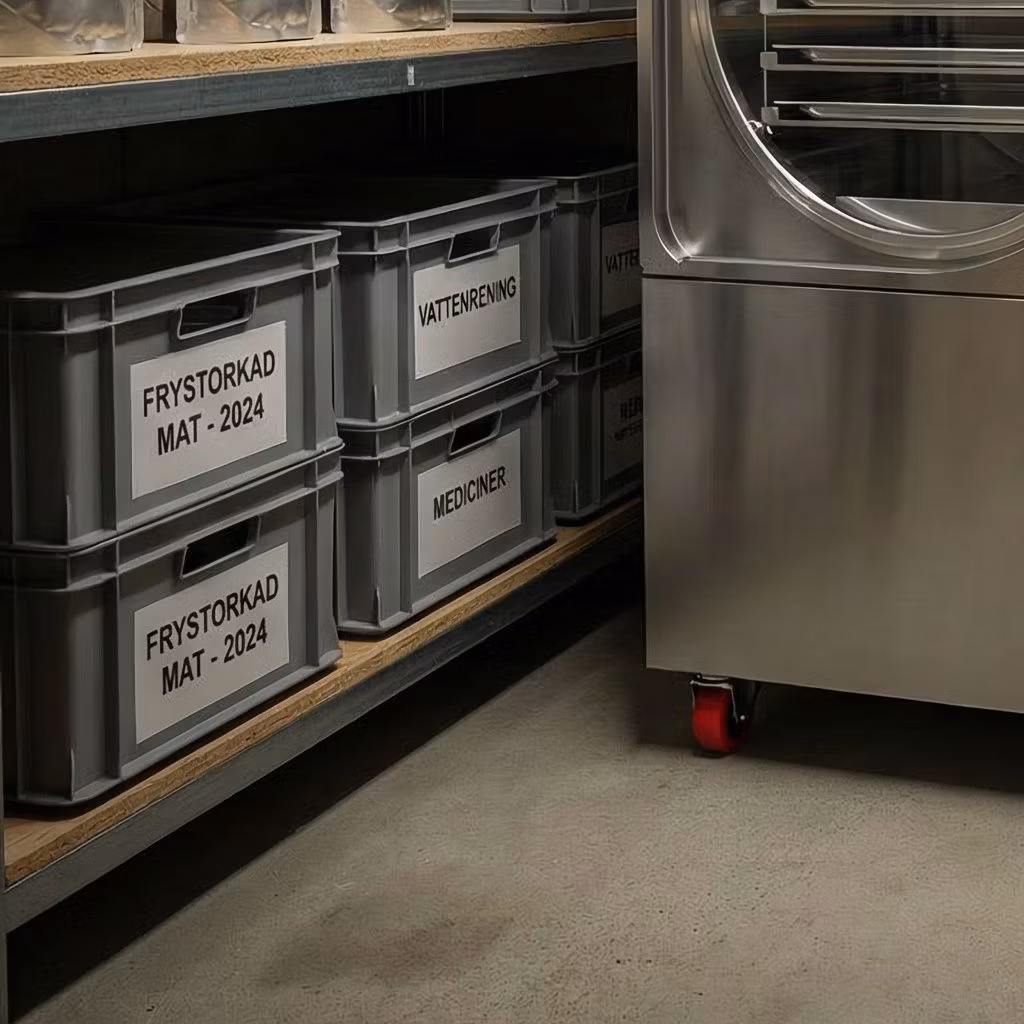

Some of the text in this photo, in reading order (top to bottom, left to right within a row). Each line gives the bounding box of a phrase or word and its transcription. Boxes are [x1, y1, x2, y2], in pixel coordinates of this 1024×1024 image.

[418, 275, 517, 328] VATTENRENING
[143, 349, 276, 418] FRYSTORKAD
[157, 413, 202, 456] MAT
[219, 392, 265, 433] 2024
[433, 465, 507, 521] MEDICINER
[146, 573, 279, 661] FRYSTORKAD
[162, 648, 205, 696] MAT
[223, 617, 268, 664] 2024
